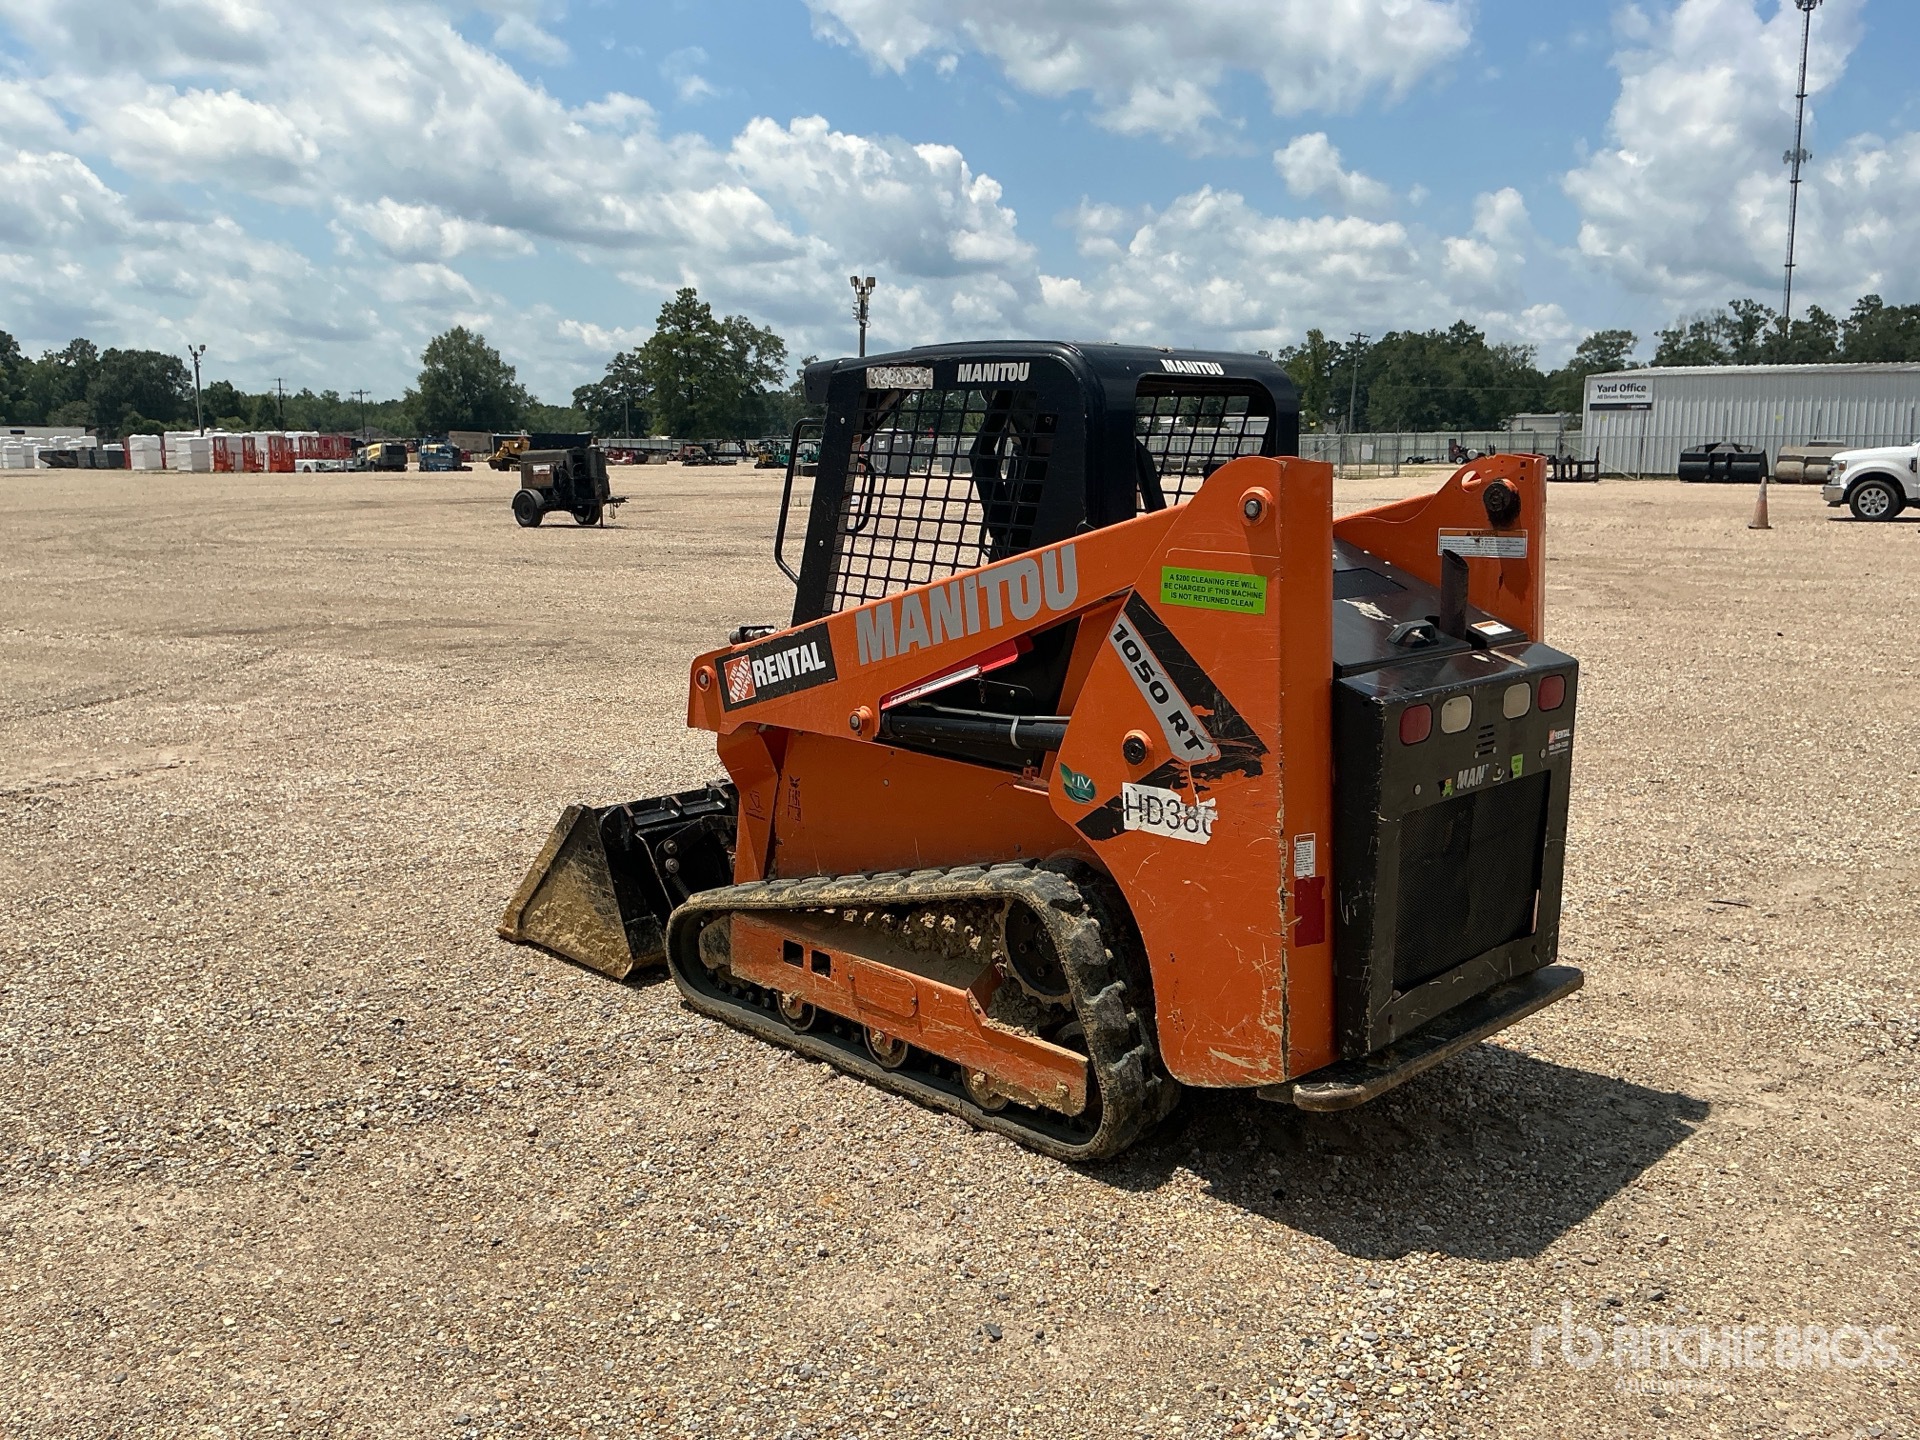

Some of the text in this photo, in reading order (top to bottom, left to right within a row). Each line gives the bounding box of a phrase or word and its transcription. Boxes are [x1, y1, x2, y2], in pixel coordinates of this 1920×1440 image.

[957, 362, 1030, 382] MANITOU
[1160, 359, 1224, 375] MANITOU
[1597, 383, 1647, 393] Yard Office
[1164, 582, 1173, 590] BE
[1174, 583, 1206, 593] CHARGED
[1214, 588, 1230, 596] THIS
[1231, 589, 1263, 599] MACHINE
[1176, 574, 1190, 582] $200
[1191, 576, 1225, 586] CLEANING
[1241, 581, 1258, 589] WILL
[855, 543, 1078, 666] MANITOU
[1178, 592, 1192, 600] NOT
[1193, 594, 1230, 605] RETURNED
[1230, 599, 1254, 607] CLEAN
[729, 663, 739, 681] THE
[751, 641, 826, 688] RENTAL
[730, 659, 749, 701] HOME
[740, 672, 753, 699] DEPOT
[1112, 623, 1205, 751] 1050 RT
[1555, 729, 1571, 740] RENTAL
